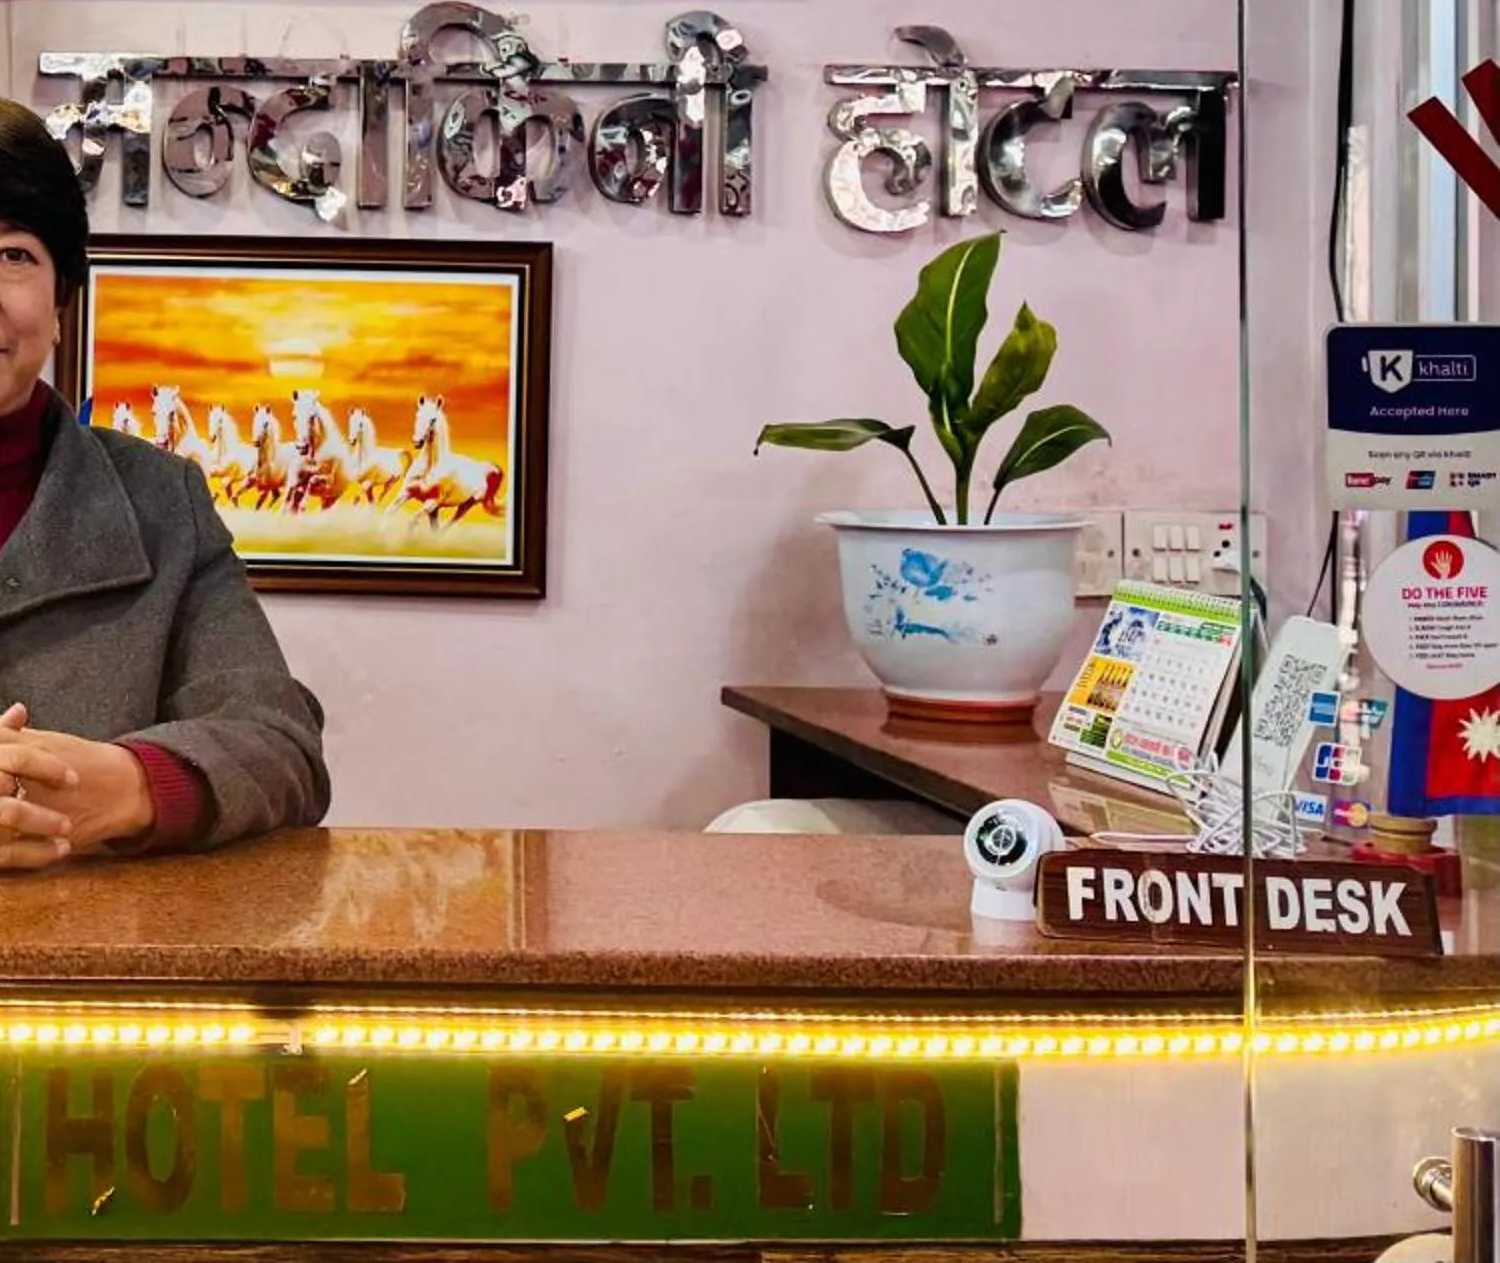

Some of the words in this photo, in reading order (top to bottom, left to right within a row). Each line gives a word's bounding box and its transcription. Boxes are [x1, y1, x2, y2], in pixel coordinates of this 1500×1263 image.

[823, 25, 1239, 233] होटल
[1419, 361, 1469, 377] khalti
[1370, 406, 1435, 420] Accepted
[1438, 407, 1469, 417] Here
[1402, 588, 1422, 599] DO
[1427, 588, 1452, 599] THE
[1457, 587, 1488, 598] FIVE
[1066, 867, 1243, 927] FRONT
[1266, 877, 1412, 936] DESK
[43, 1067, 405, 1213] HOTEL
[487, 1065, 715, 1213] PVT.
[758, 1065, 946, 1213] LTD
